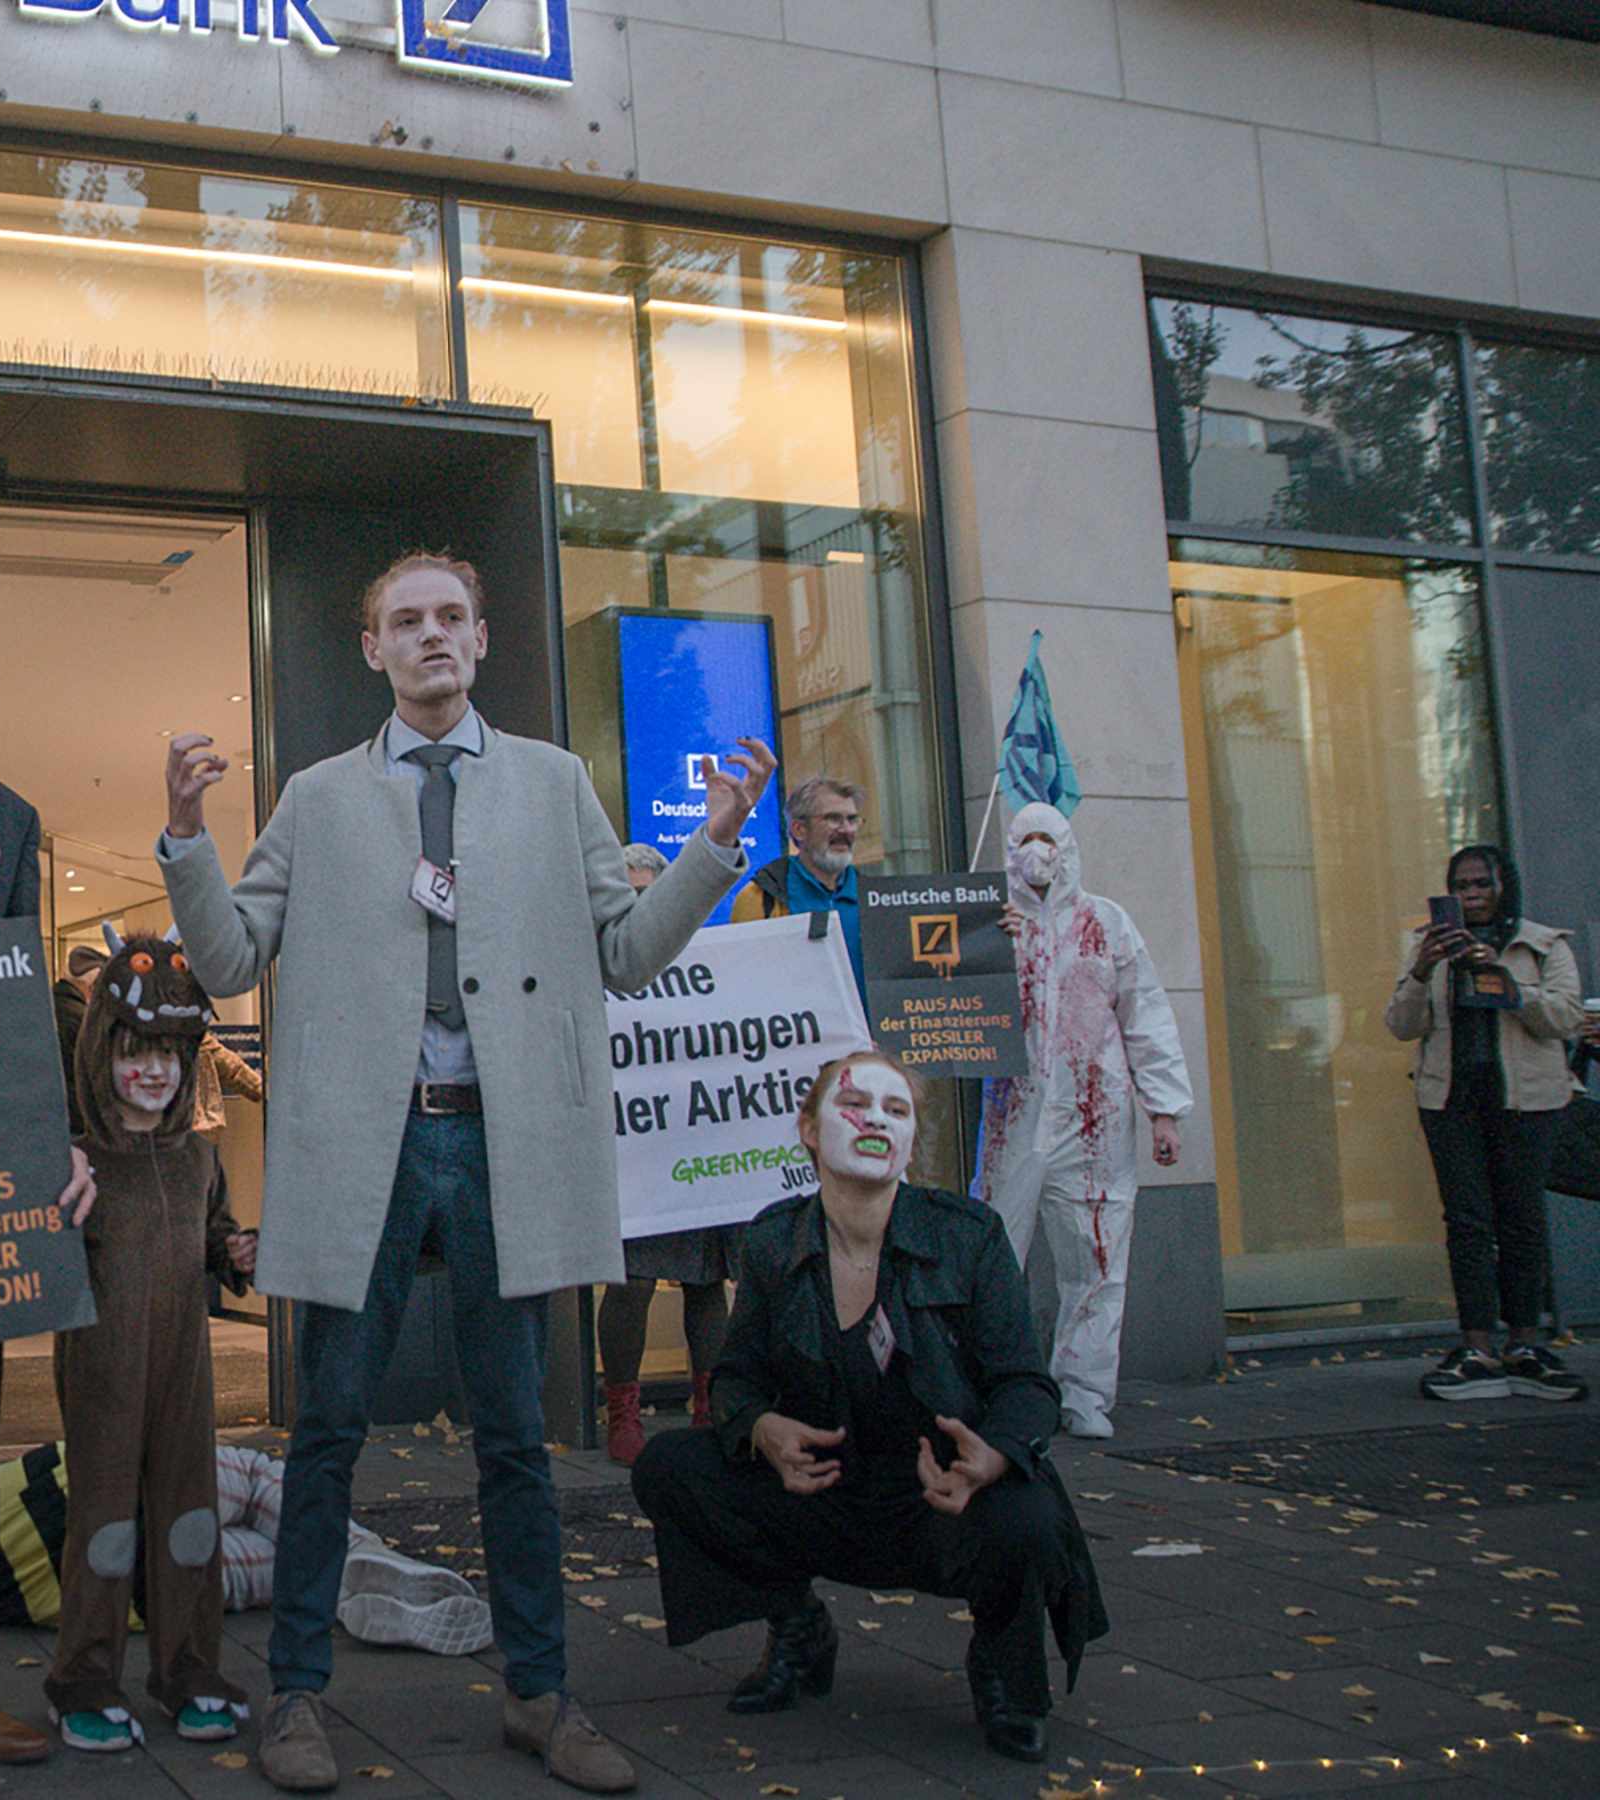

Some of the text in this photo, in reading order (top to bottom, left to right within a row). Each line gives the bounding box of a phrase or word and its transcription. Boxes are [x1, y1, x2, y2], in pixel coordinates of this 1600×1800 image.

[868, 885, 1001, 907] Deutsche Bank
[903, 995, 984, 1014] RAUS AUS
[879, 1014, 1012, 1032] der Finanzierung
[910, 1029, 985, 1048] FOSSILER
[901, 1046, 998, 1065] EXPANSION!
